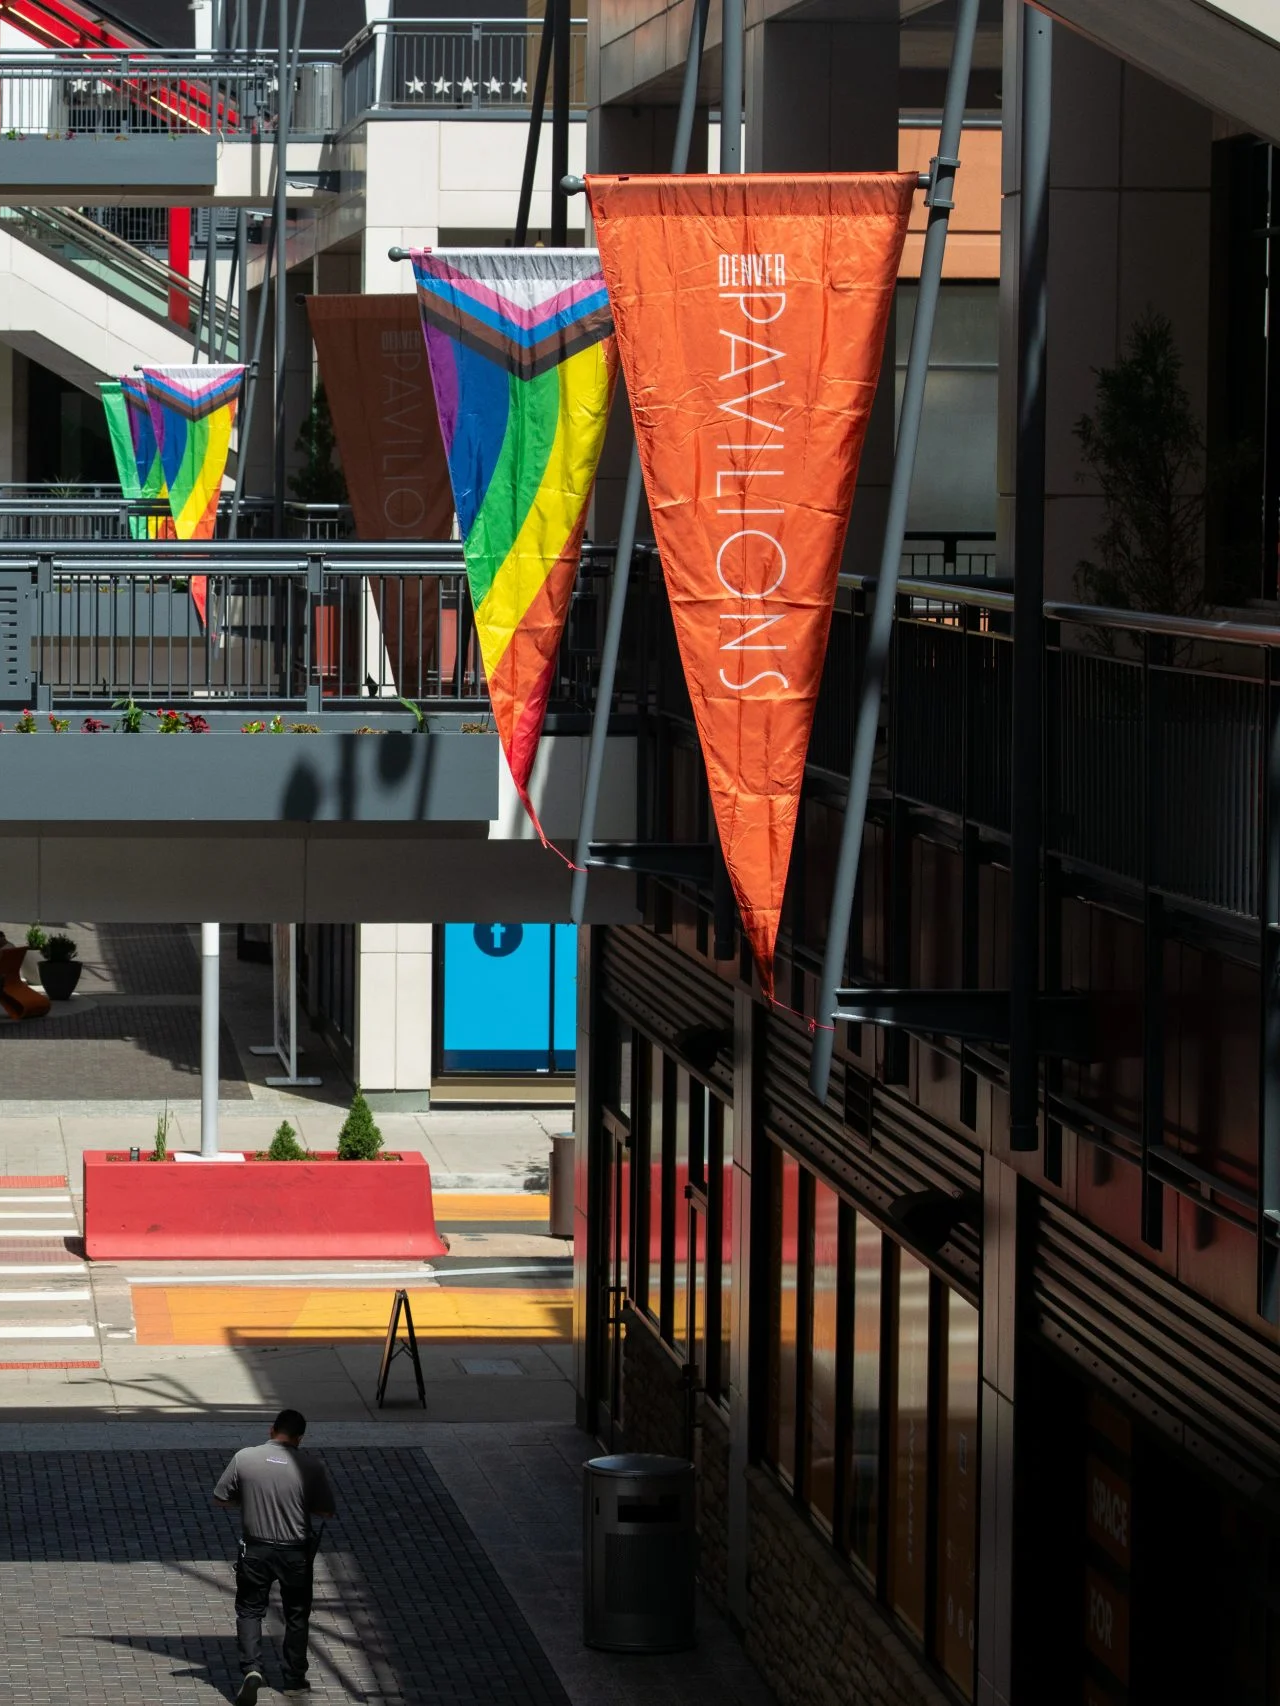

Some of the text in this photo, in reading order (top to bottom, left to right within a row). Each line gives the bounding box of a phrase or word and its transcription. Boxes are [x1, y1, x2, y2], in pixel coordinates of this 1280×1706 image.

[718, 253, 787, 287] DENVER
[381, 352, 426, 540] PAVILIO
[715, 291, 790, 693] PAVILIONS
[1091, 1476, 1128, 1548] SPACE
[1089, 1585, 1113, 1651] FOR
